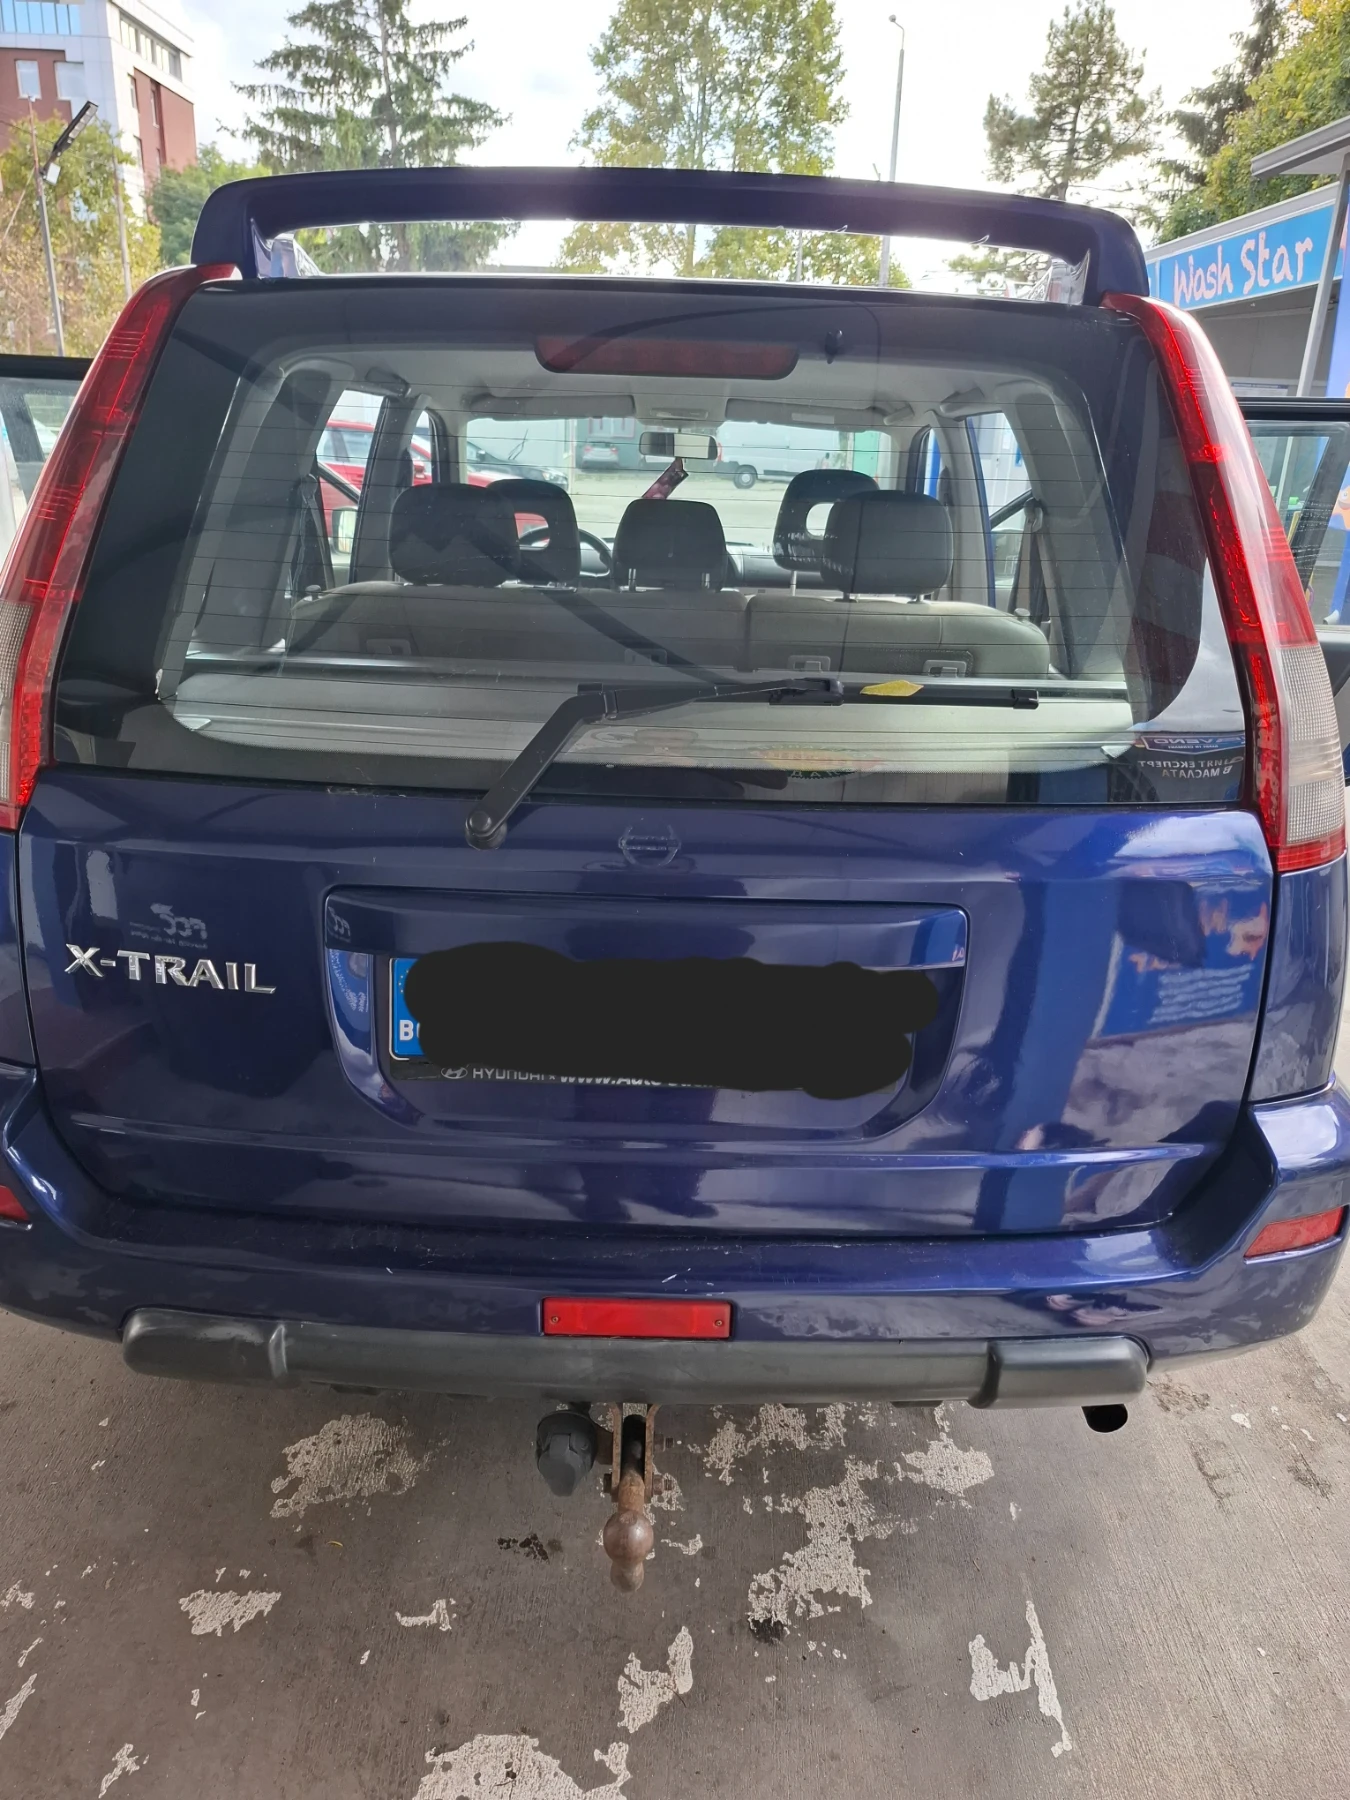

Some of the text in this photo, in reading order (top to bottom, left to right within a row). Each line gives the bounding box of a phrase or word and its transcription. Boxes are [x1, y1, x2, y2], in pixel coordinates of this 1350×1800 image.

[1173, 231, 1313, 306] Wash Star
[64, 943, 277, 994] X-TRAIL
[399, 1019, 420, 1041] B
